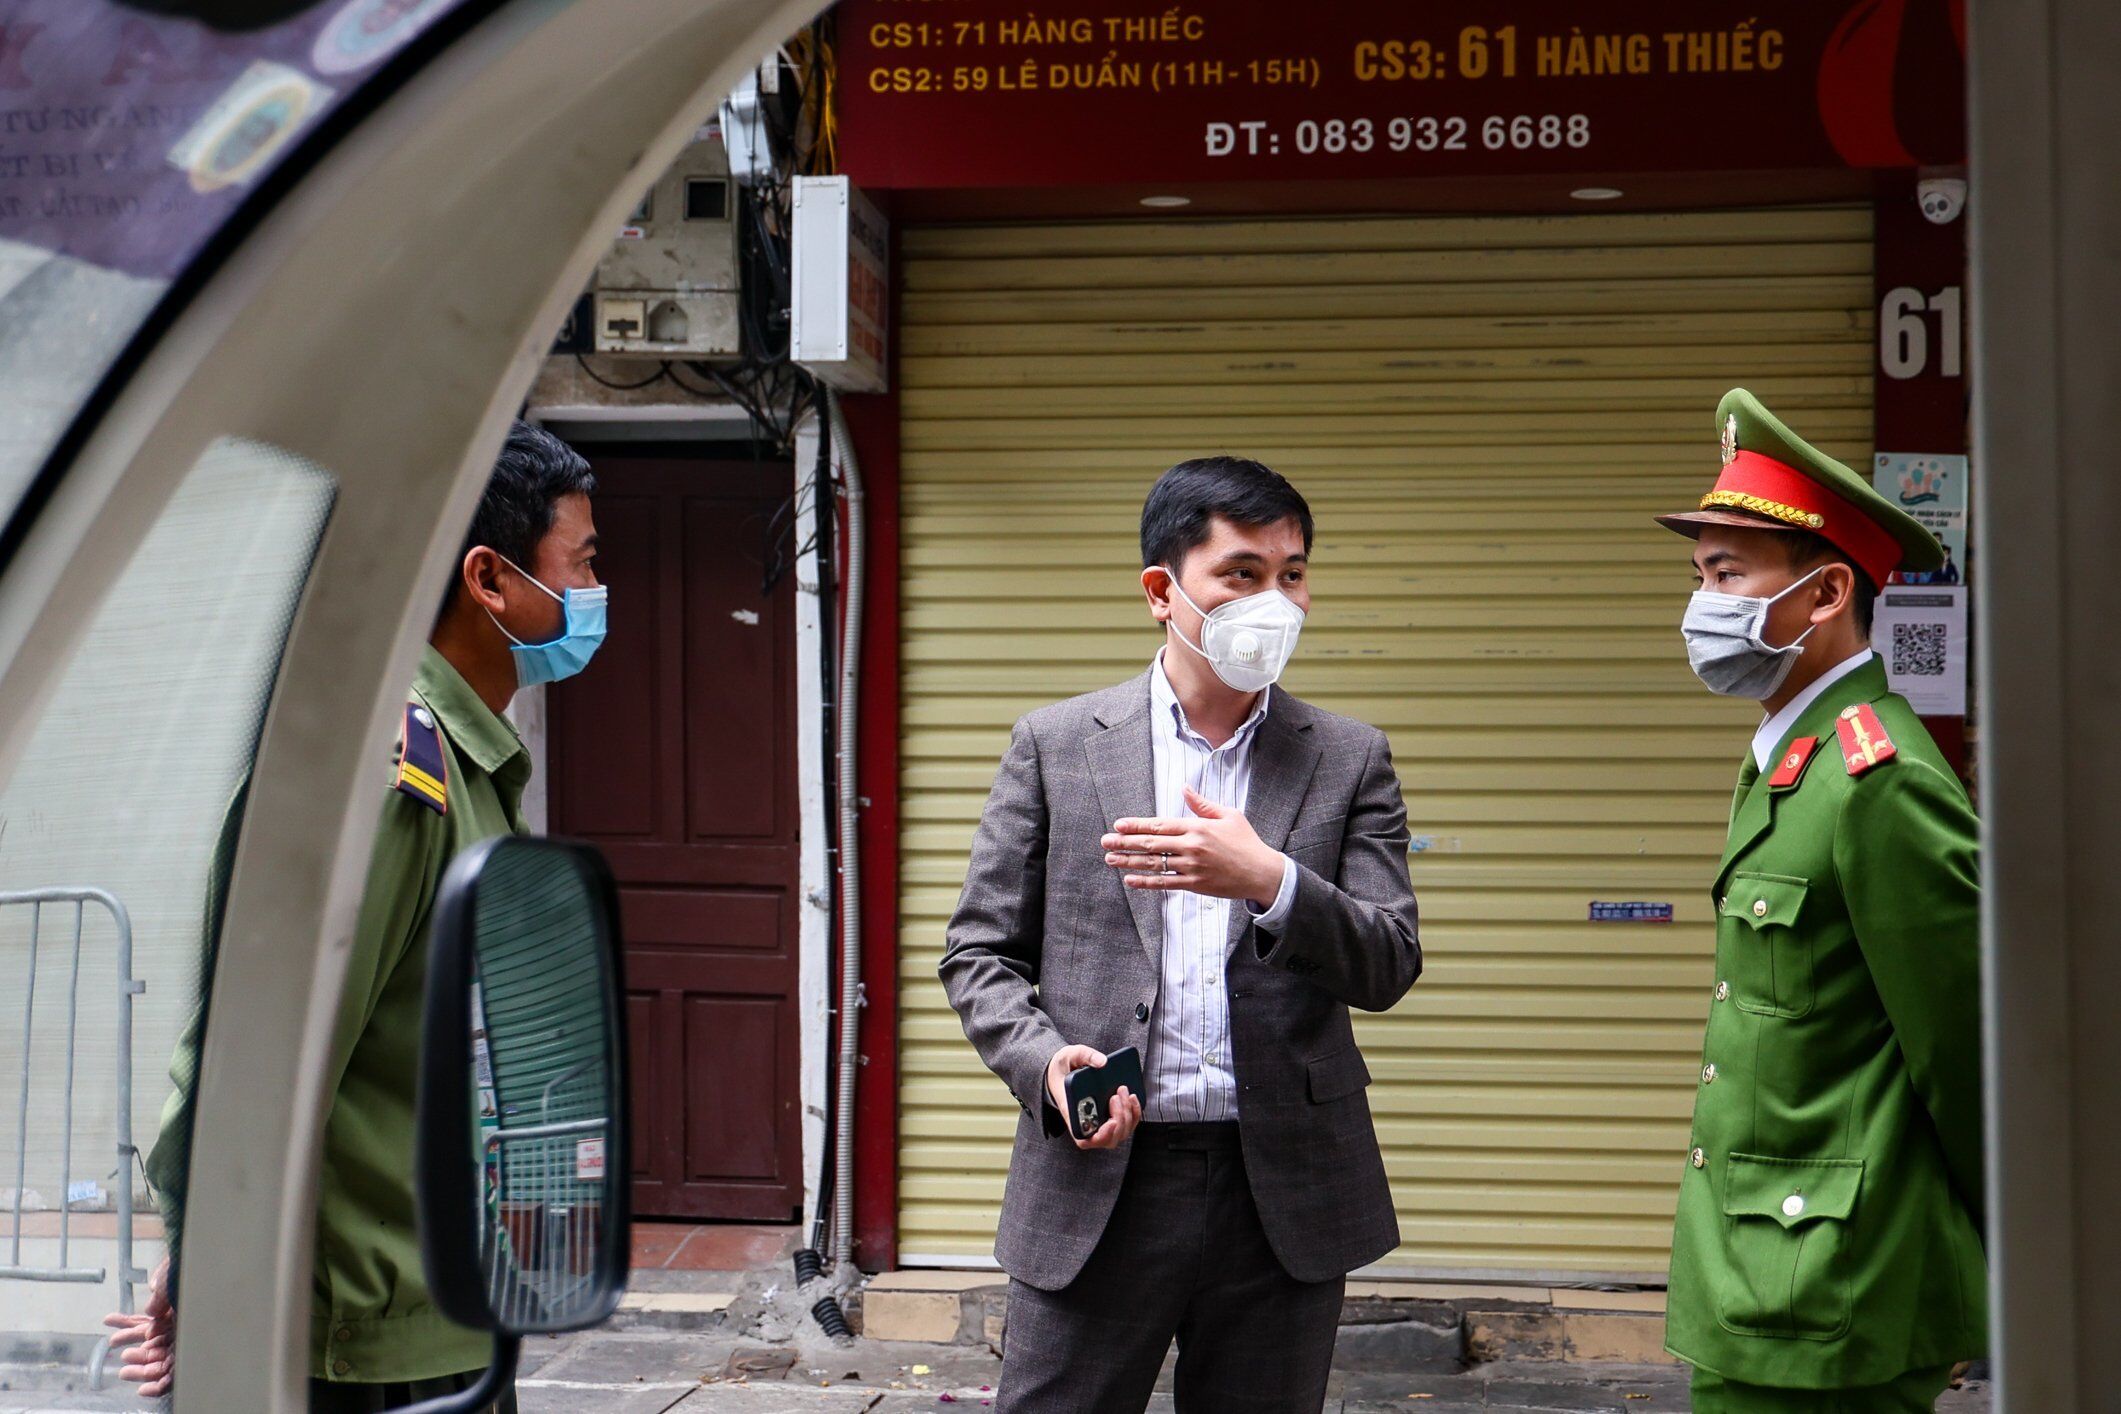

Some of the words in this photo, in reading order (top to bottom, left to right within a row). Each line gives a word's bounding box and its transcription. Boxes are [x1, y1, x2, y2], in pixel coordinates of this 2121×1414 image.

[870, 22, 942, 48] CS1:
[953, 22, 984, 45] 71
[999, 13, 1092, 44] HÀNG
[1103, 8, 1203, 41] THIẾC
[1355, 40, 1445, 81] CS3:
[1459, 26, 1515, 78] 61
[1538, 27, 1649, 76] HÀNG
[1664, 18, 1782, 72] THIẾC
[869, 67, 942, 93] CS2:
[953, 66, 988, 91] 59
[999, 59, 1038, 89] LÊ
[1049, 51, 1140, 88] DUẨN
[1205, 121, 1279, 156] ĐT:
[1295, 118, 1374, 154] 083
[1388, 117, 1467, 151] 932
[1482, 114, 1590, 150] 6688
[1881, 287, 1960, 379] 61
